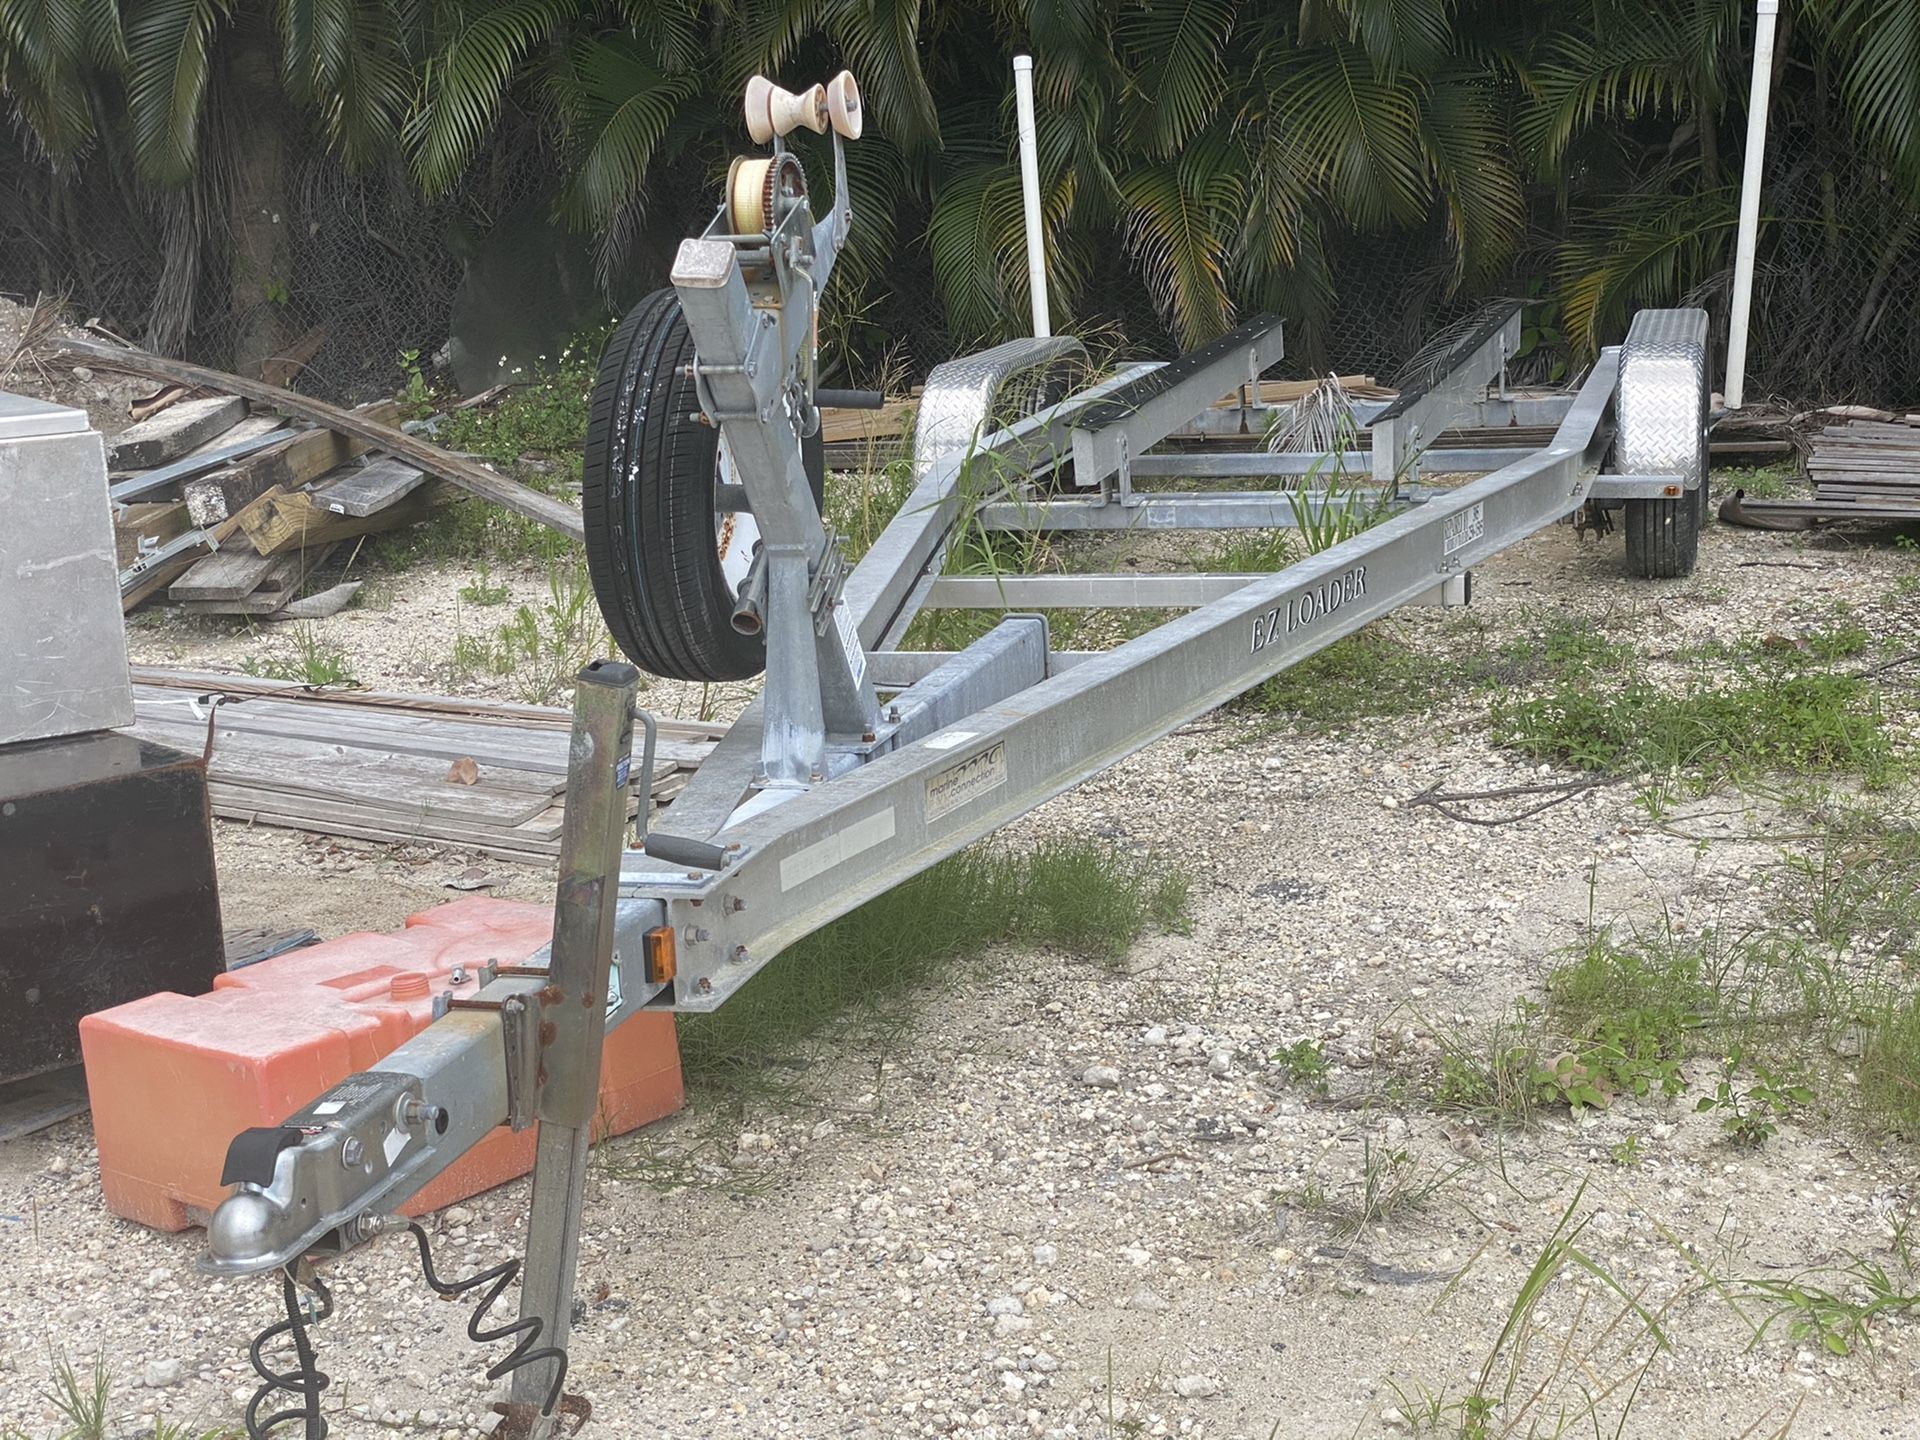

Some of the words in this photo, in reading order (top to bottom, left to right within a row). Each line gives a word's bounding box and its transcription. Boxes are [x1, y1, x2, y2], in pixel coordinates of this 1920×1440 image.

[1250, 605, 1280, 654] EZ
[1286, 566, 1366, 635] LOADER
[930, 775, 958, 798] marine
[950, 767, 994, 797] connection
